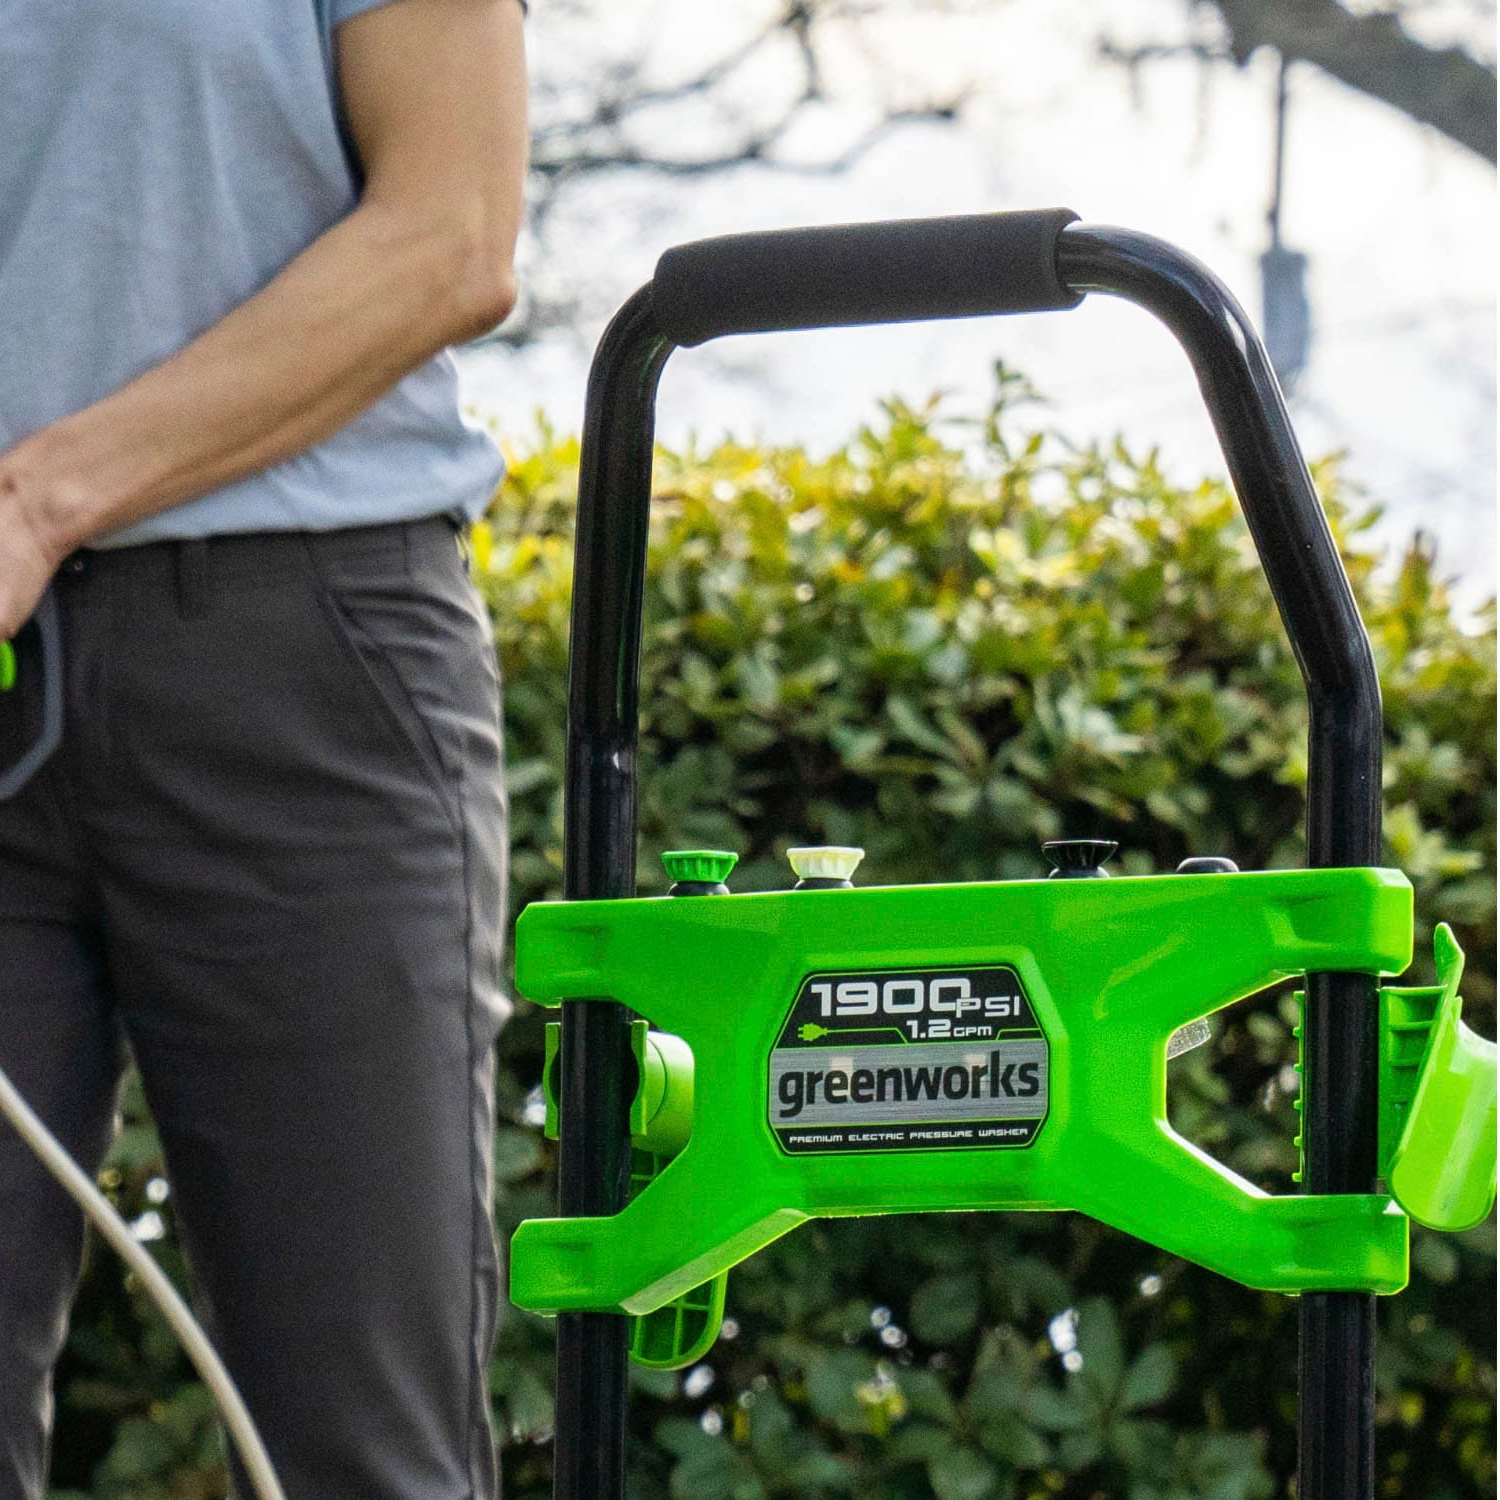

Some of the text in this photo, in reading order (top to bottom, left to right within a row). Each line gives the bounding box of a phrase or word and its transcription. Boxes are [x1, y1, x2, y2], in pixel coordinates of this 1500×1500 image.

[810, 977, 1020, 1018] 1900 PSI
[906, 1018, 992, 1039] 1.2 GPM
[778, 1050, 1040, 1118] greenworks
[789, 1128, 1029, 1144] PREMIUM ELECTRIC PRESSURE WASHER
